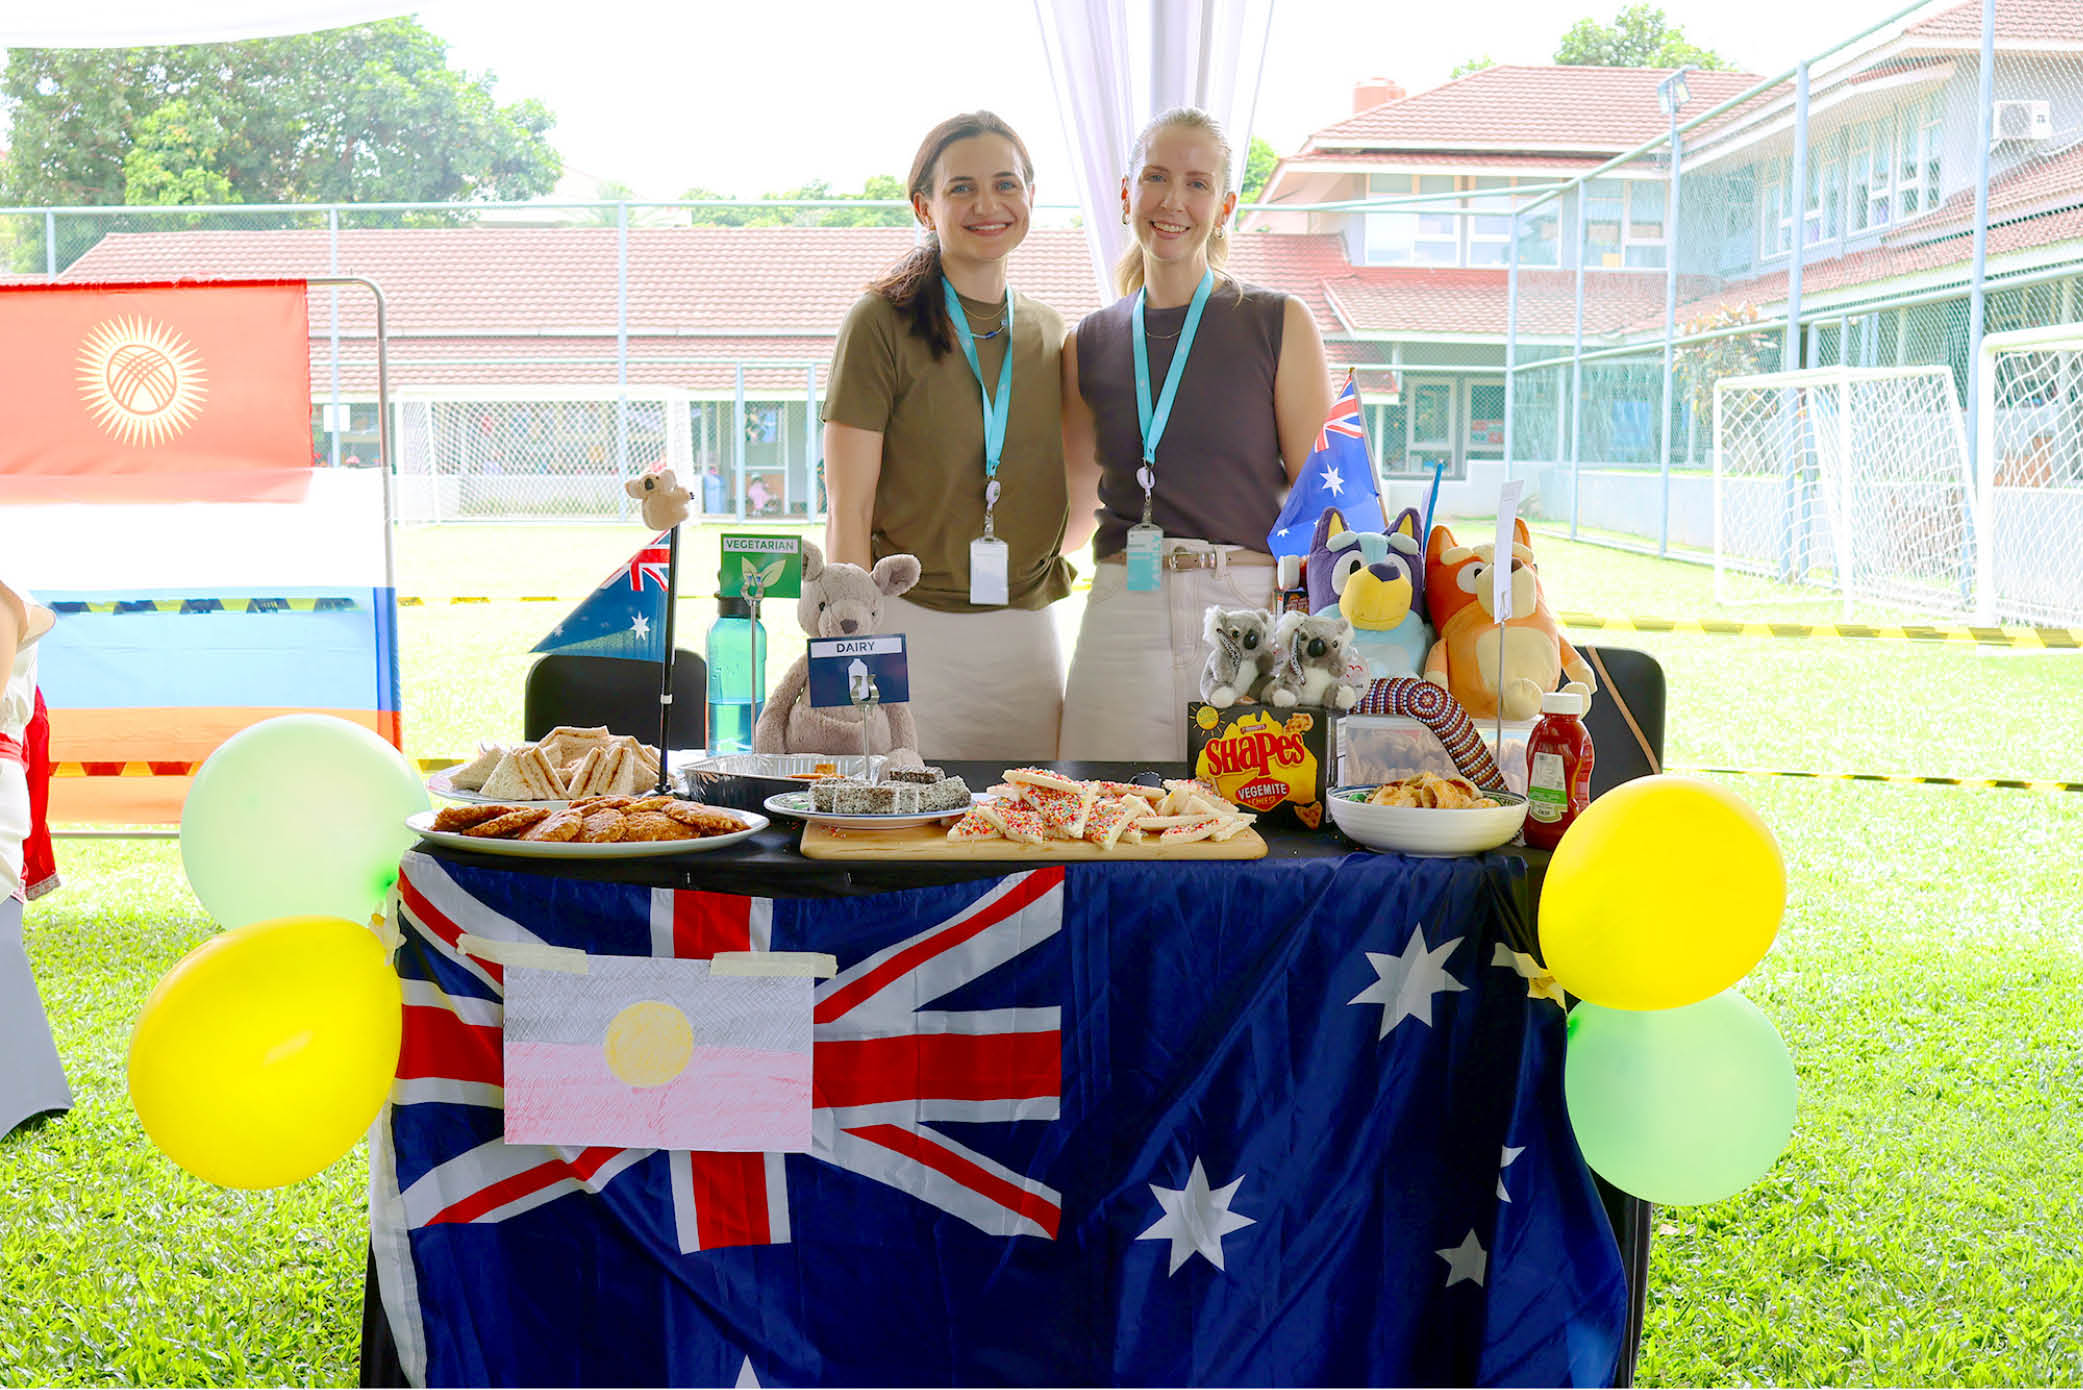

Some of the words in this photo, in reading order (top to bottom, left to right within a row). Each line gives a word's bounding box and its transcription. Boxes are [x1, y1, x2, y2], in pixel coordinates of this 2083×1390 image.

[727, 539, 794, 550] VEGETARIAN
[836, 641, 875, 653] DAIRY
[1238, 783, 1288, 800] VEGEMITE
